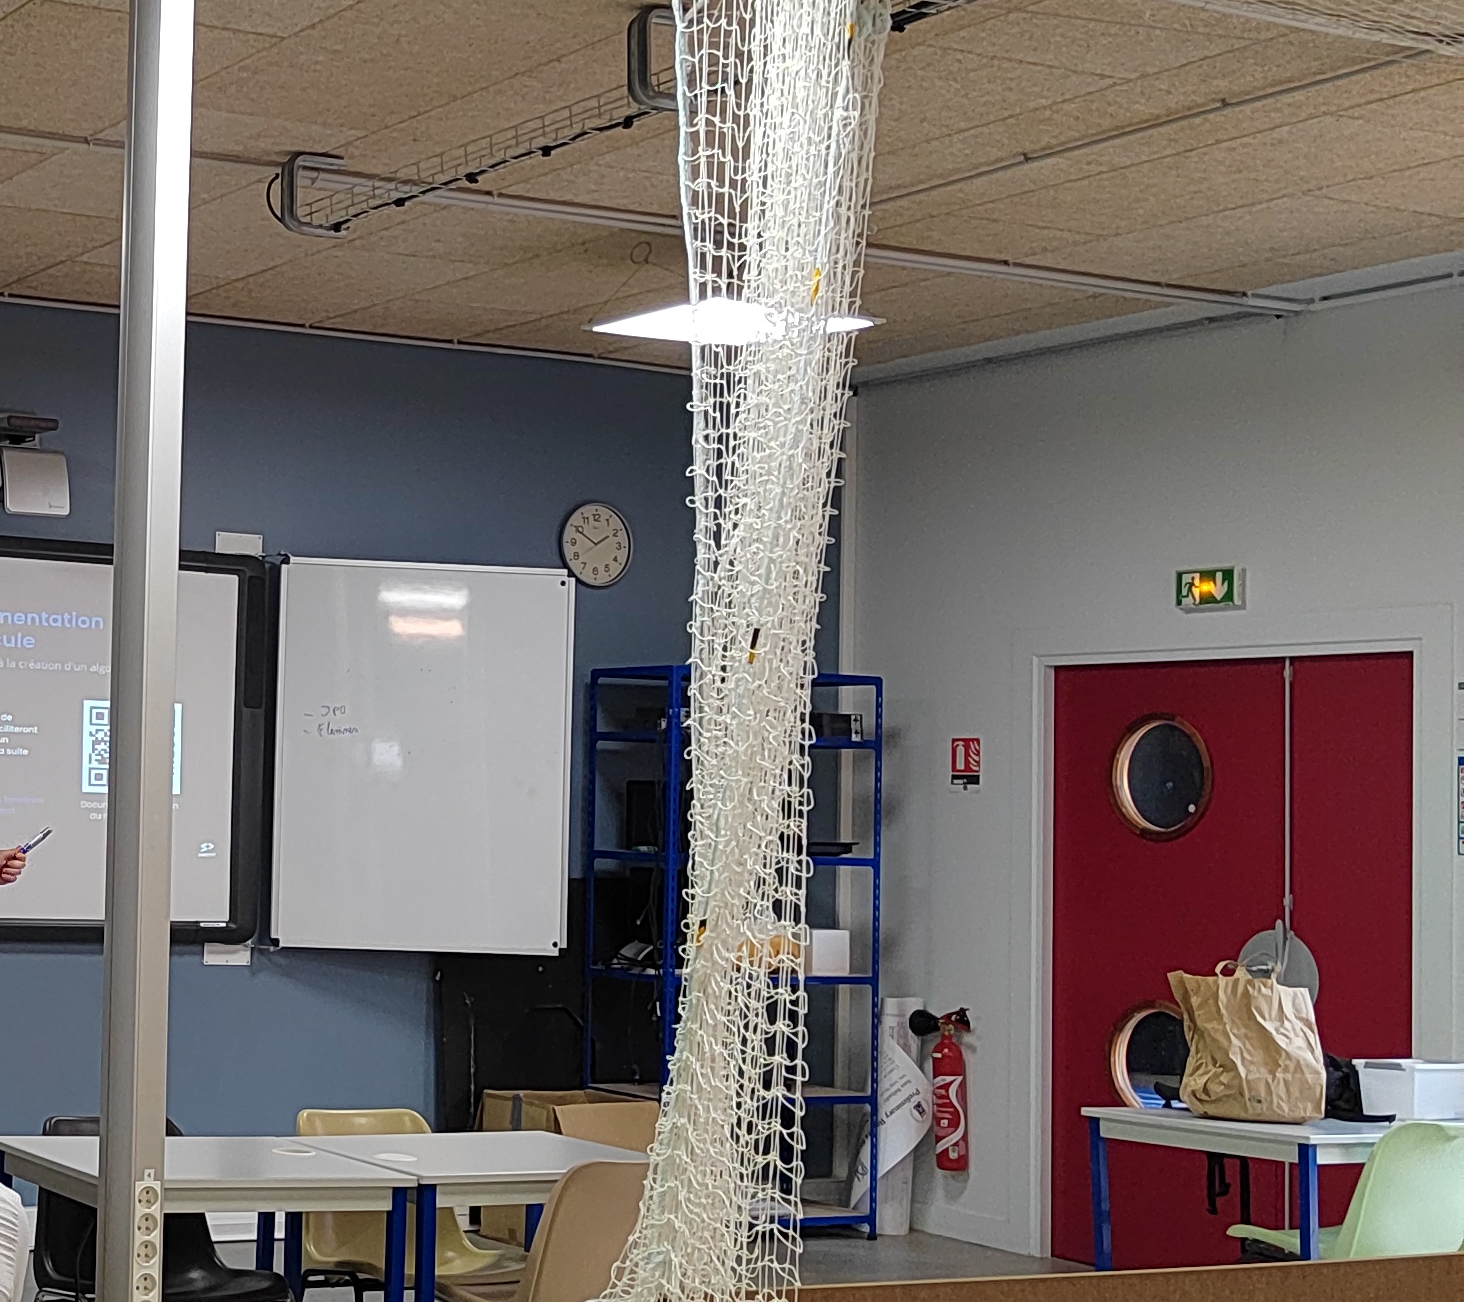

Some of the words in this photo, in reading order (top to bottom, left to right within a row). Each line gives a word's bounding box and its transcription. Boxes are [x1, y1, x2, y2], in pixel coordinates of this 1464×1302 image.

[582, 516, 590, 525] 11
[592, 513, 601, 523] 12
[612, 528, 619, 537] 2
[570, 537, 577, 547] 9
[616, 541, 622, 551] 3
[573, 551, 580, 561] 8
[613, 555, 618, 564] 4
[581, 561, 587, 570] 7
[604, 563, 610, 573] 5
[592, 566, 599, 576] 6
[7, 657, 16, 668] la
[19, 658, 62, 671] création
[64, 661, 87, 672] d'un
[0, 713, 12, 722] de
[7, 747, 29, 756] suite
